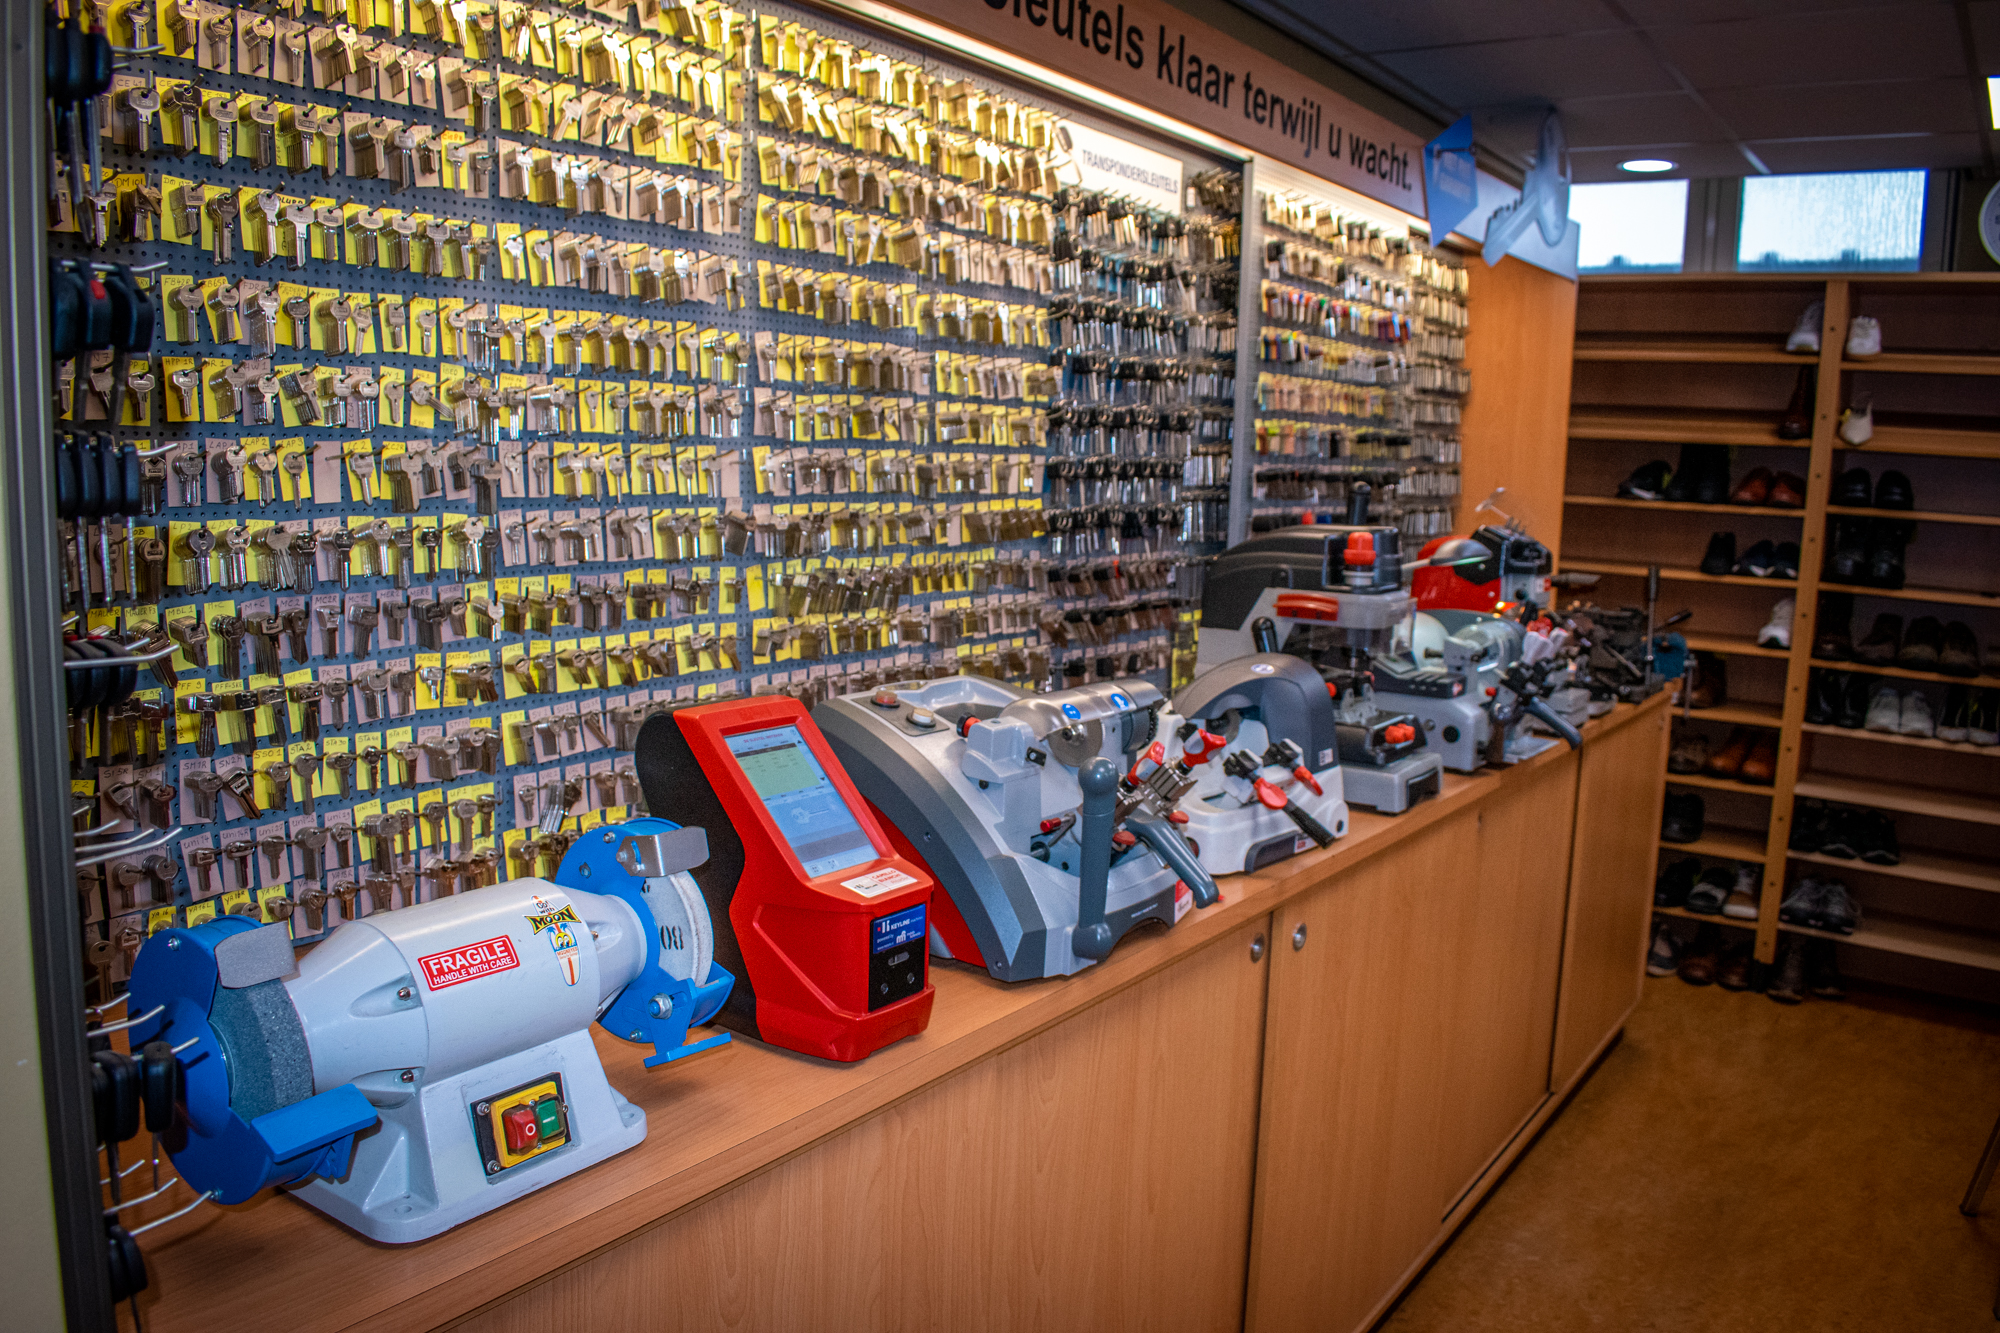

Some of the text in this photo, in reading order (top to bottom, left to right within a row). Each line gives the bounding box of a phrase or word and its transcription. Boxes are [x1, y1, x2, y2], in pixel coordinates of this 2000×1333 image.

[984, 0, 1143, 69] eutels
[1157, 25, 1234, 108] klaar
[1243, 71, 1321, 158] terwijl
[1329, 123, 1341, 159] u
[1350, 133, 1412, 191] wacht.
[1083, 149, 1178, 194] TRANSPONDERSLEUTELS
[530, 907, 577, 931] MOON
[891, 919, 911, 930] KEYLINE
[428, 942, 509, 975] FRAGILE
[433, 956, 513, 985] HANDLE WITH CARE
